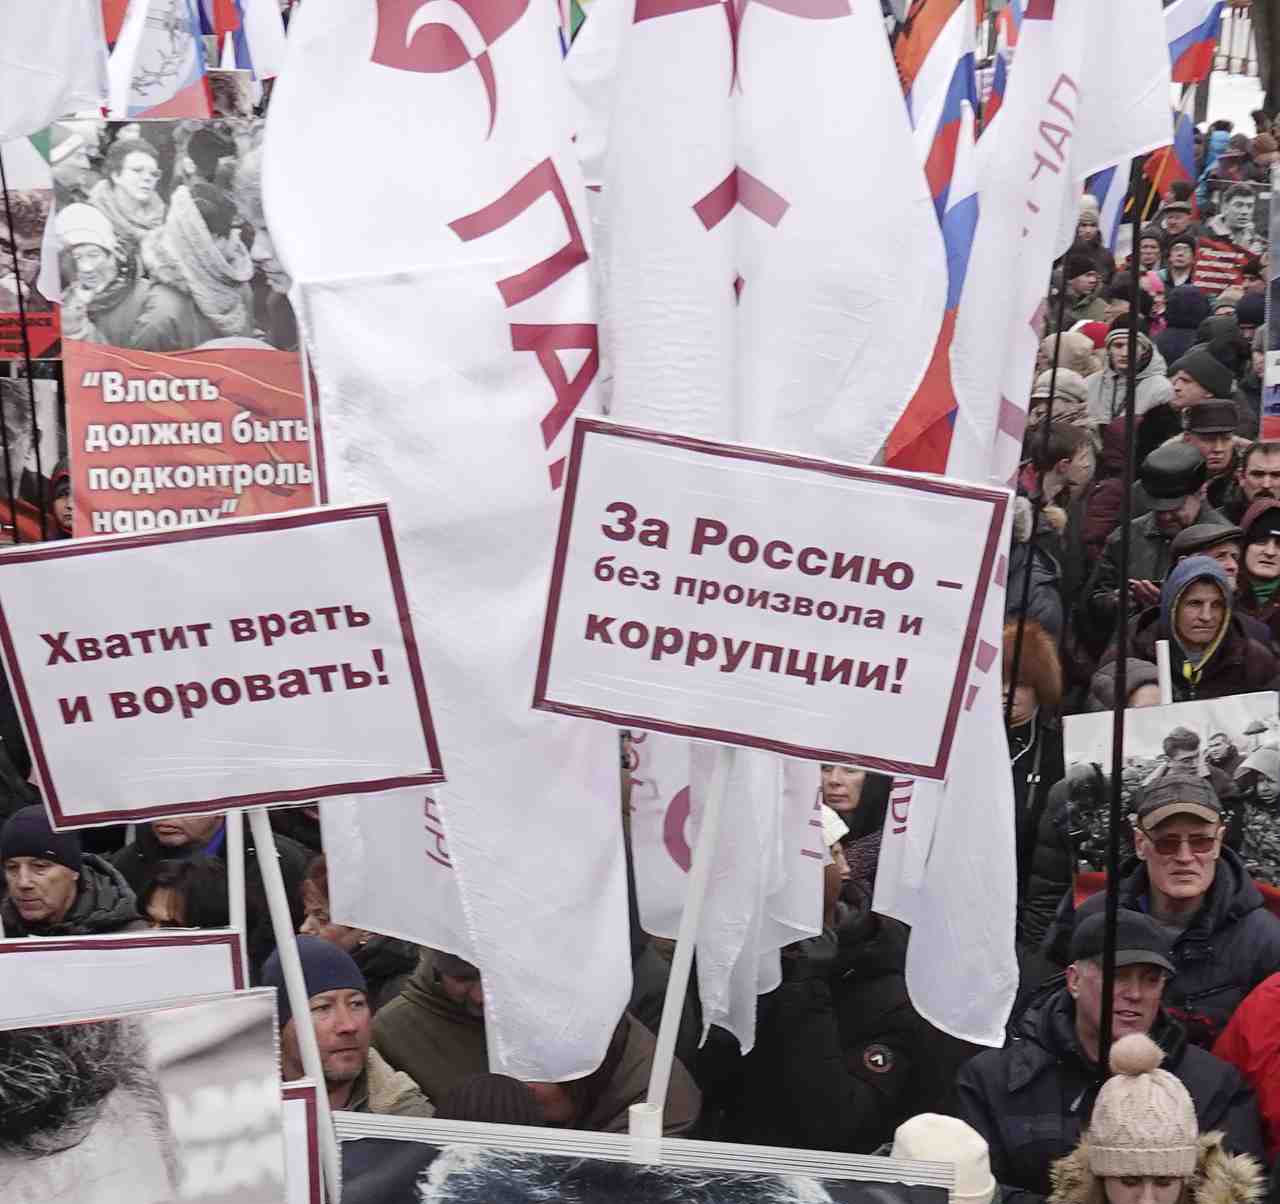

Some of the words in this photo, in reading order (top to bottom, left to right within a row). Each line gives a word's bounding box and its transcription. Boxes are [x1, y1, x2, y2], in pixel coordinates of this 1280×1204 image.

[81, 371, 221, 403] “Власть
[85, 421, 224, 452] должна
[601, 501, 670, 550] За
[689, 516, 915, 592] Россию
[39, 621, 214, 667] Хватит
[231, 602, 372, 645] врать
[593, 555, 662, 593] без
[673, 573, 886, 630] произвола
[900, 611, 924, 637] и
[57, 693, 95, 726] и
[109, 648, 390, 721] воровать!
[582, 610, 911, 695] коррупции!
